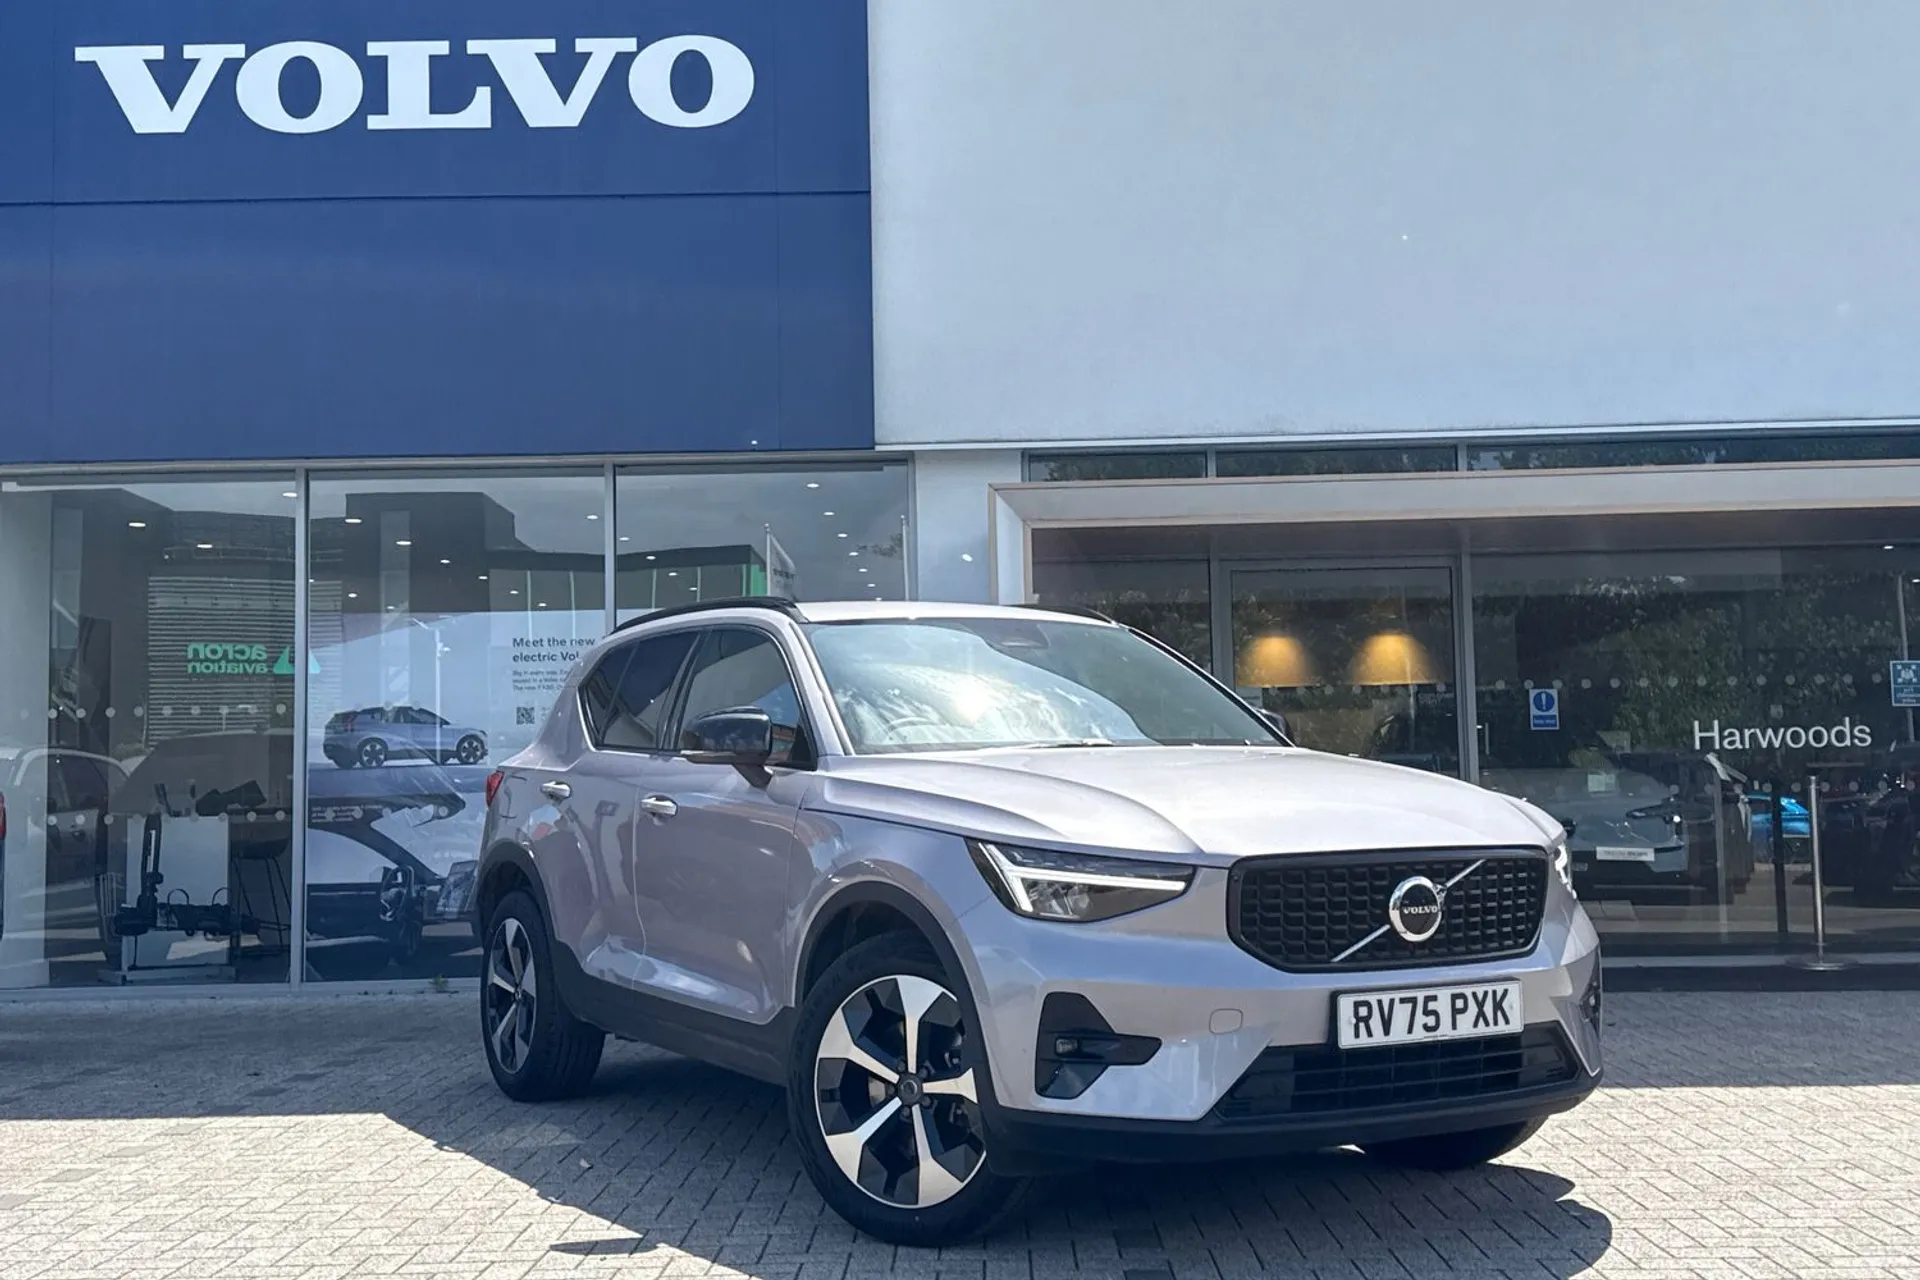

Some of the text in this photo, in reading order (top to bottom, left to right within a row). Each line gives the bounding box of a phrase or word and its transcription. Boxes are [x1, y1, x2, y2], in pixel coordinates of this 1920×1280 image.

[74, 34, 755, 135] VOLVO
[512, 637, 595, 648] Meet the new
[512, 652, 557, 662] electric
[1693, 716, 1873, 750] Harwoods
[1402, 905, 1438, 914] VOLVO
[1353, 988, 1511, 1039] RV75 PXK
